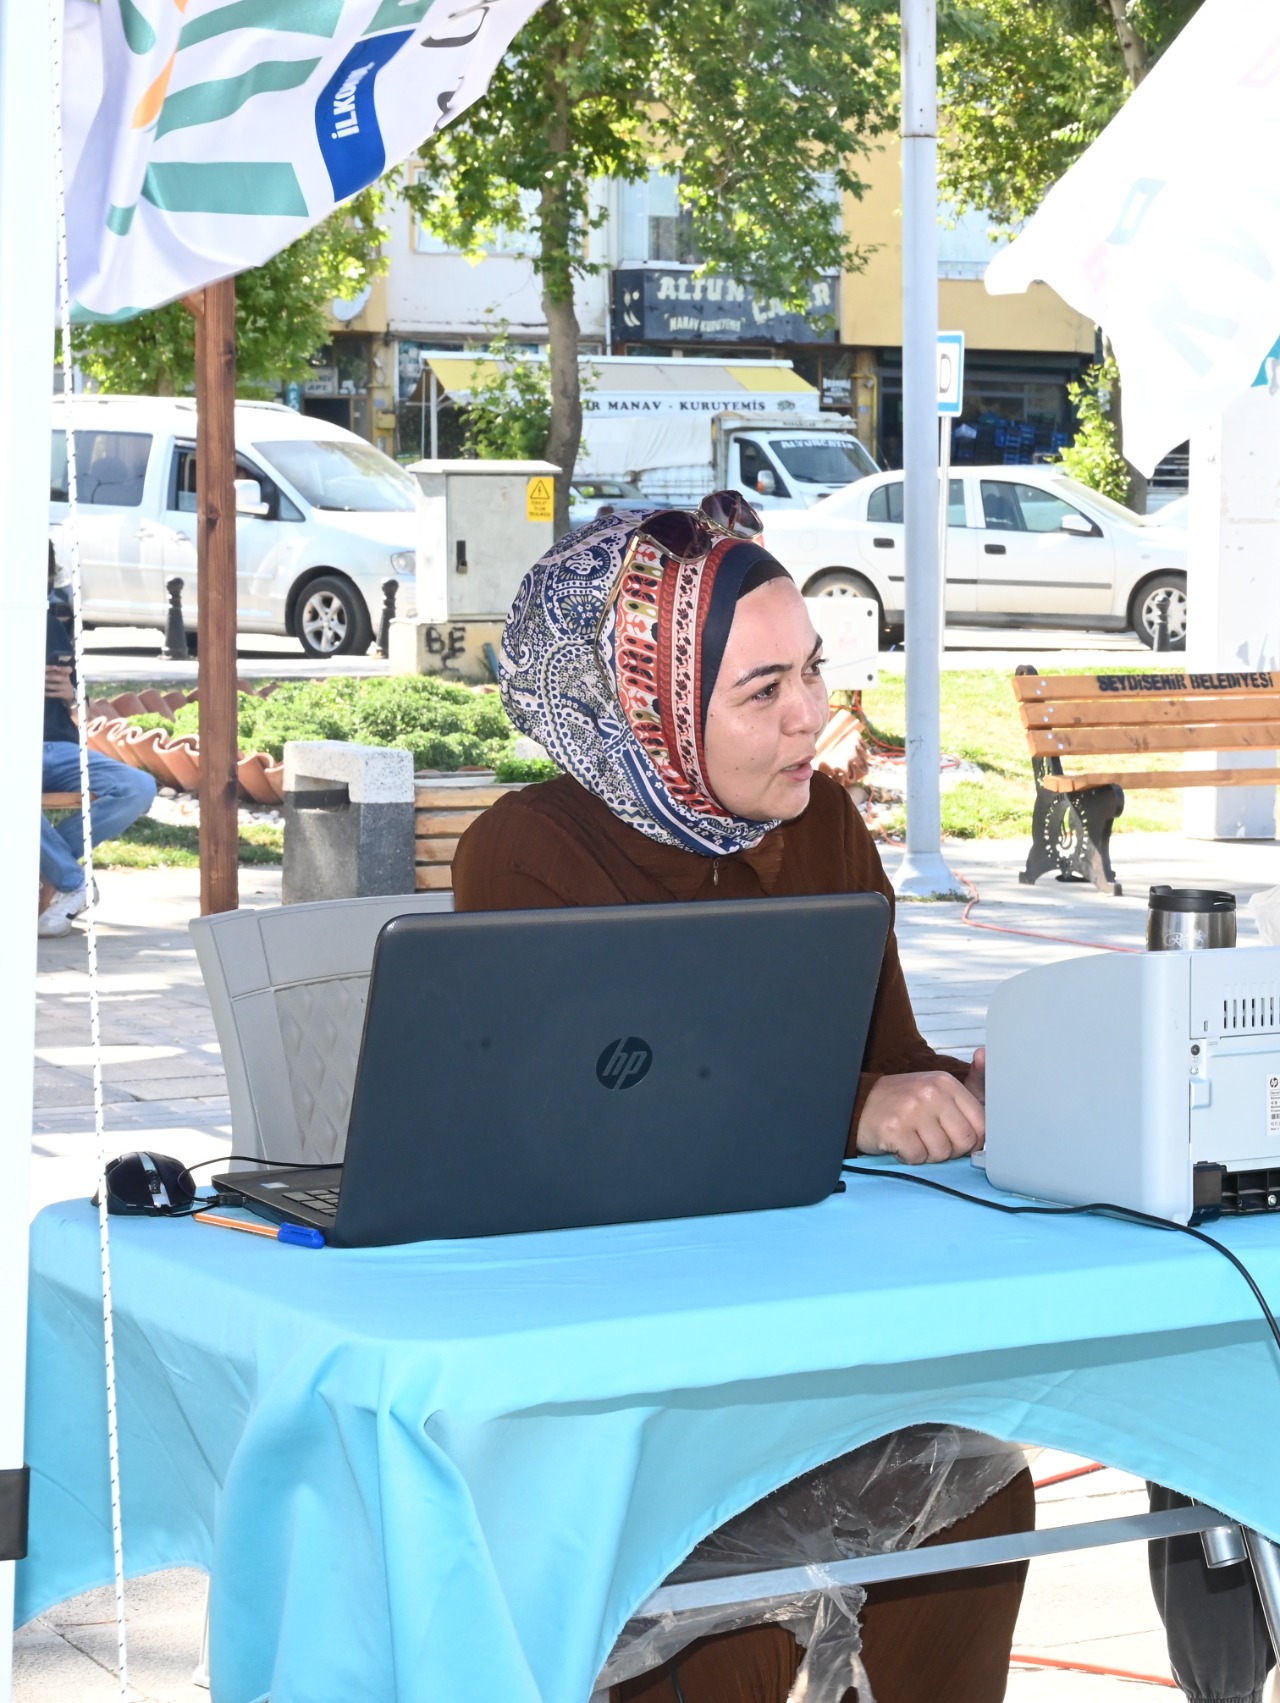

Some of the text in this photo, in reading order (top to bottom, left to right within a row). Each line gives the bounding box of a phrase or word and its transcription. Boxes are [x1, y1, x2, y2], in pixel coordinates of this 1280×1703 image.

[608, 401, 661, 410] MANAV
[1189, 672, 1274, 689] BELEDİYESİ
[601, 1036, 649, 1091] hp
